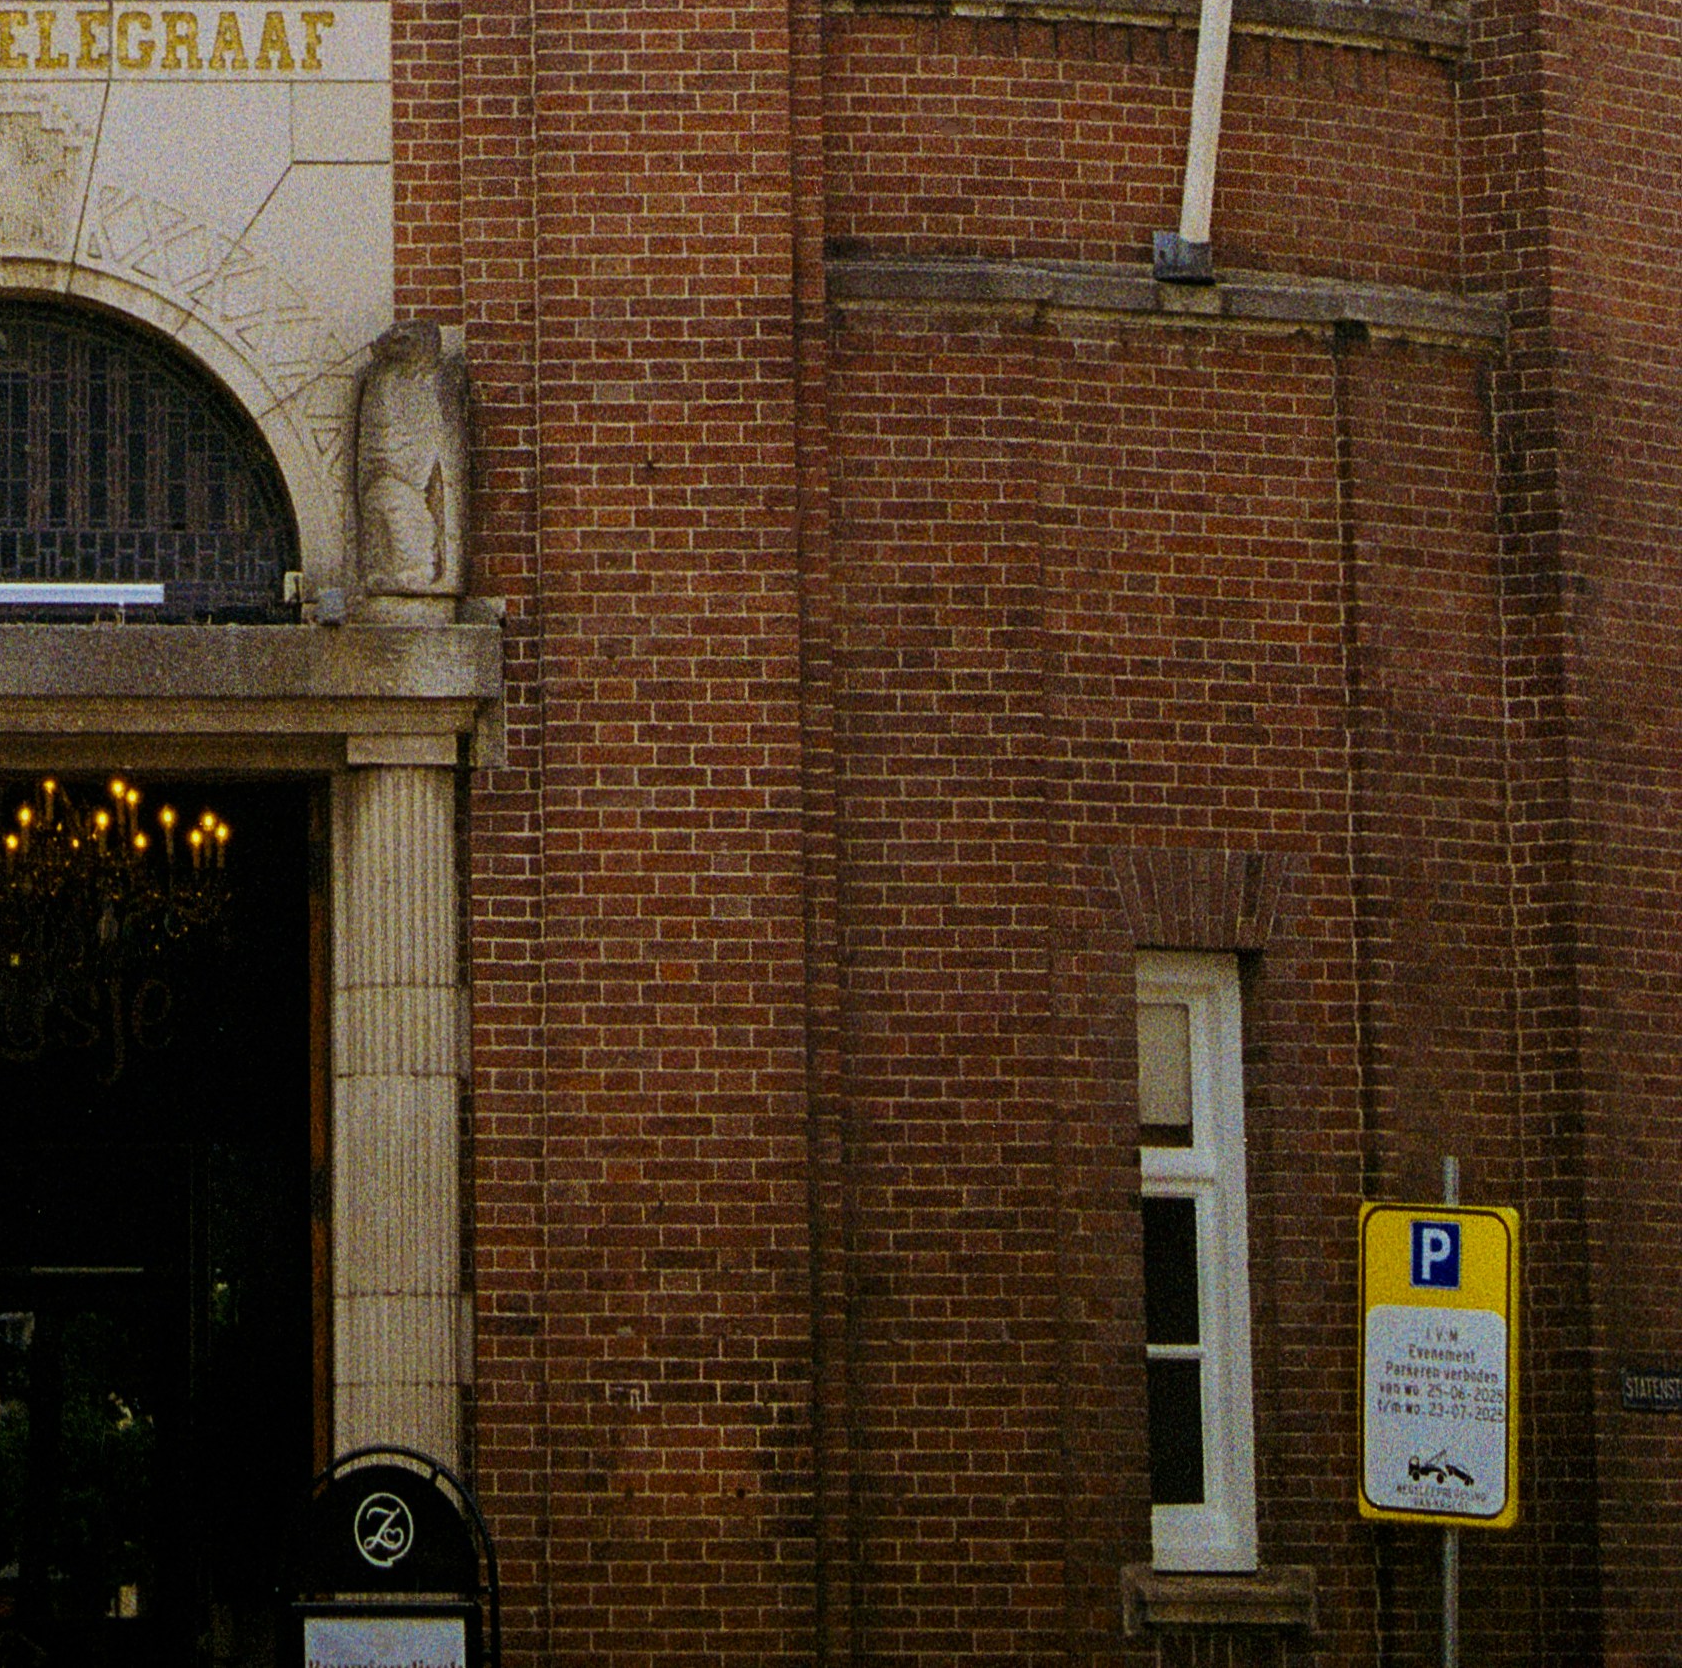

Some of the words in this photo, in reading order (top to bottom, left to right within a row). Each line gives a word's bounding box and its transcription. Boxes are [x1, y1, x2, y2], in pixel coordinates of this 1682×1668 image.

[1422, 1228, 1451, 1280] P
[1408, 1344, 1477, 1363] Evenement
[1385, 1360, 1440, 1379] Parkeren
[1444, 1367, 1499, 1384] verboden
